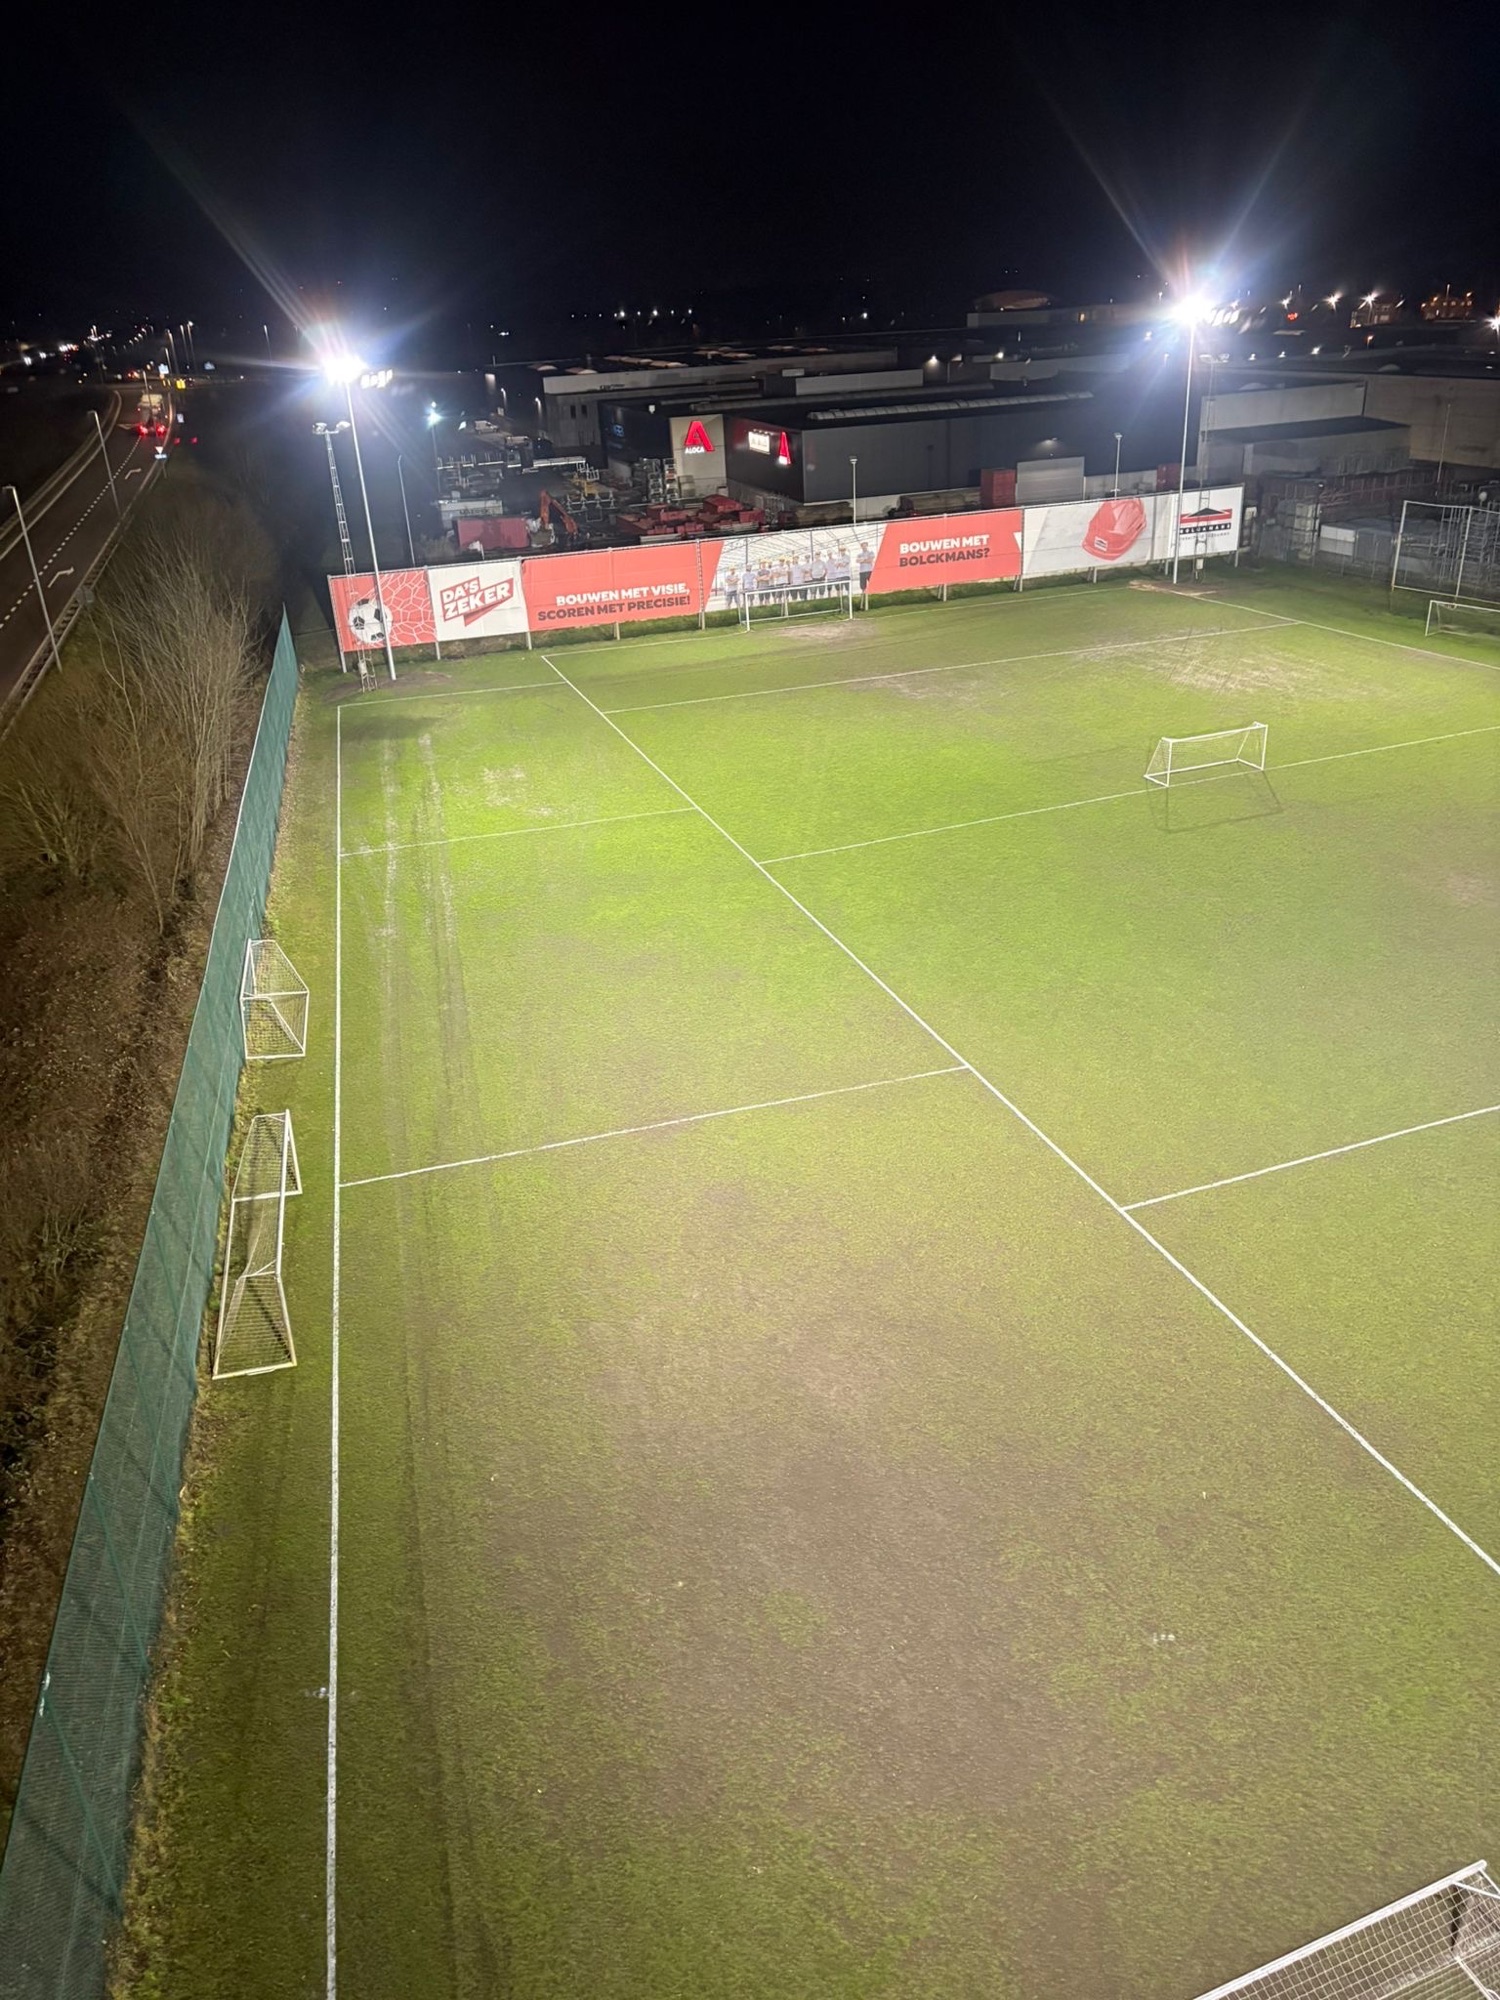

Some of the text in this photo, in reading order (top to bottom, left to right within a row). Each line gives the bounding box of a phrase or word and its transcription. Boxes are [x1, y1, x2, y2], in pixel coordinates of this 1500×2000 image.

[899, 534, 990, 554] BOUWEN MET
[899, 548, 990, 567] BOLCKMANS?
[442, 579, 479, 604] DA'S
[444, 582, 511, 619] ZEKER
[556, 583, 690, 606] BOUWEN MET VISIE,
[538, 595, 690, 621] SCOREN MET PRECISIE!
